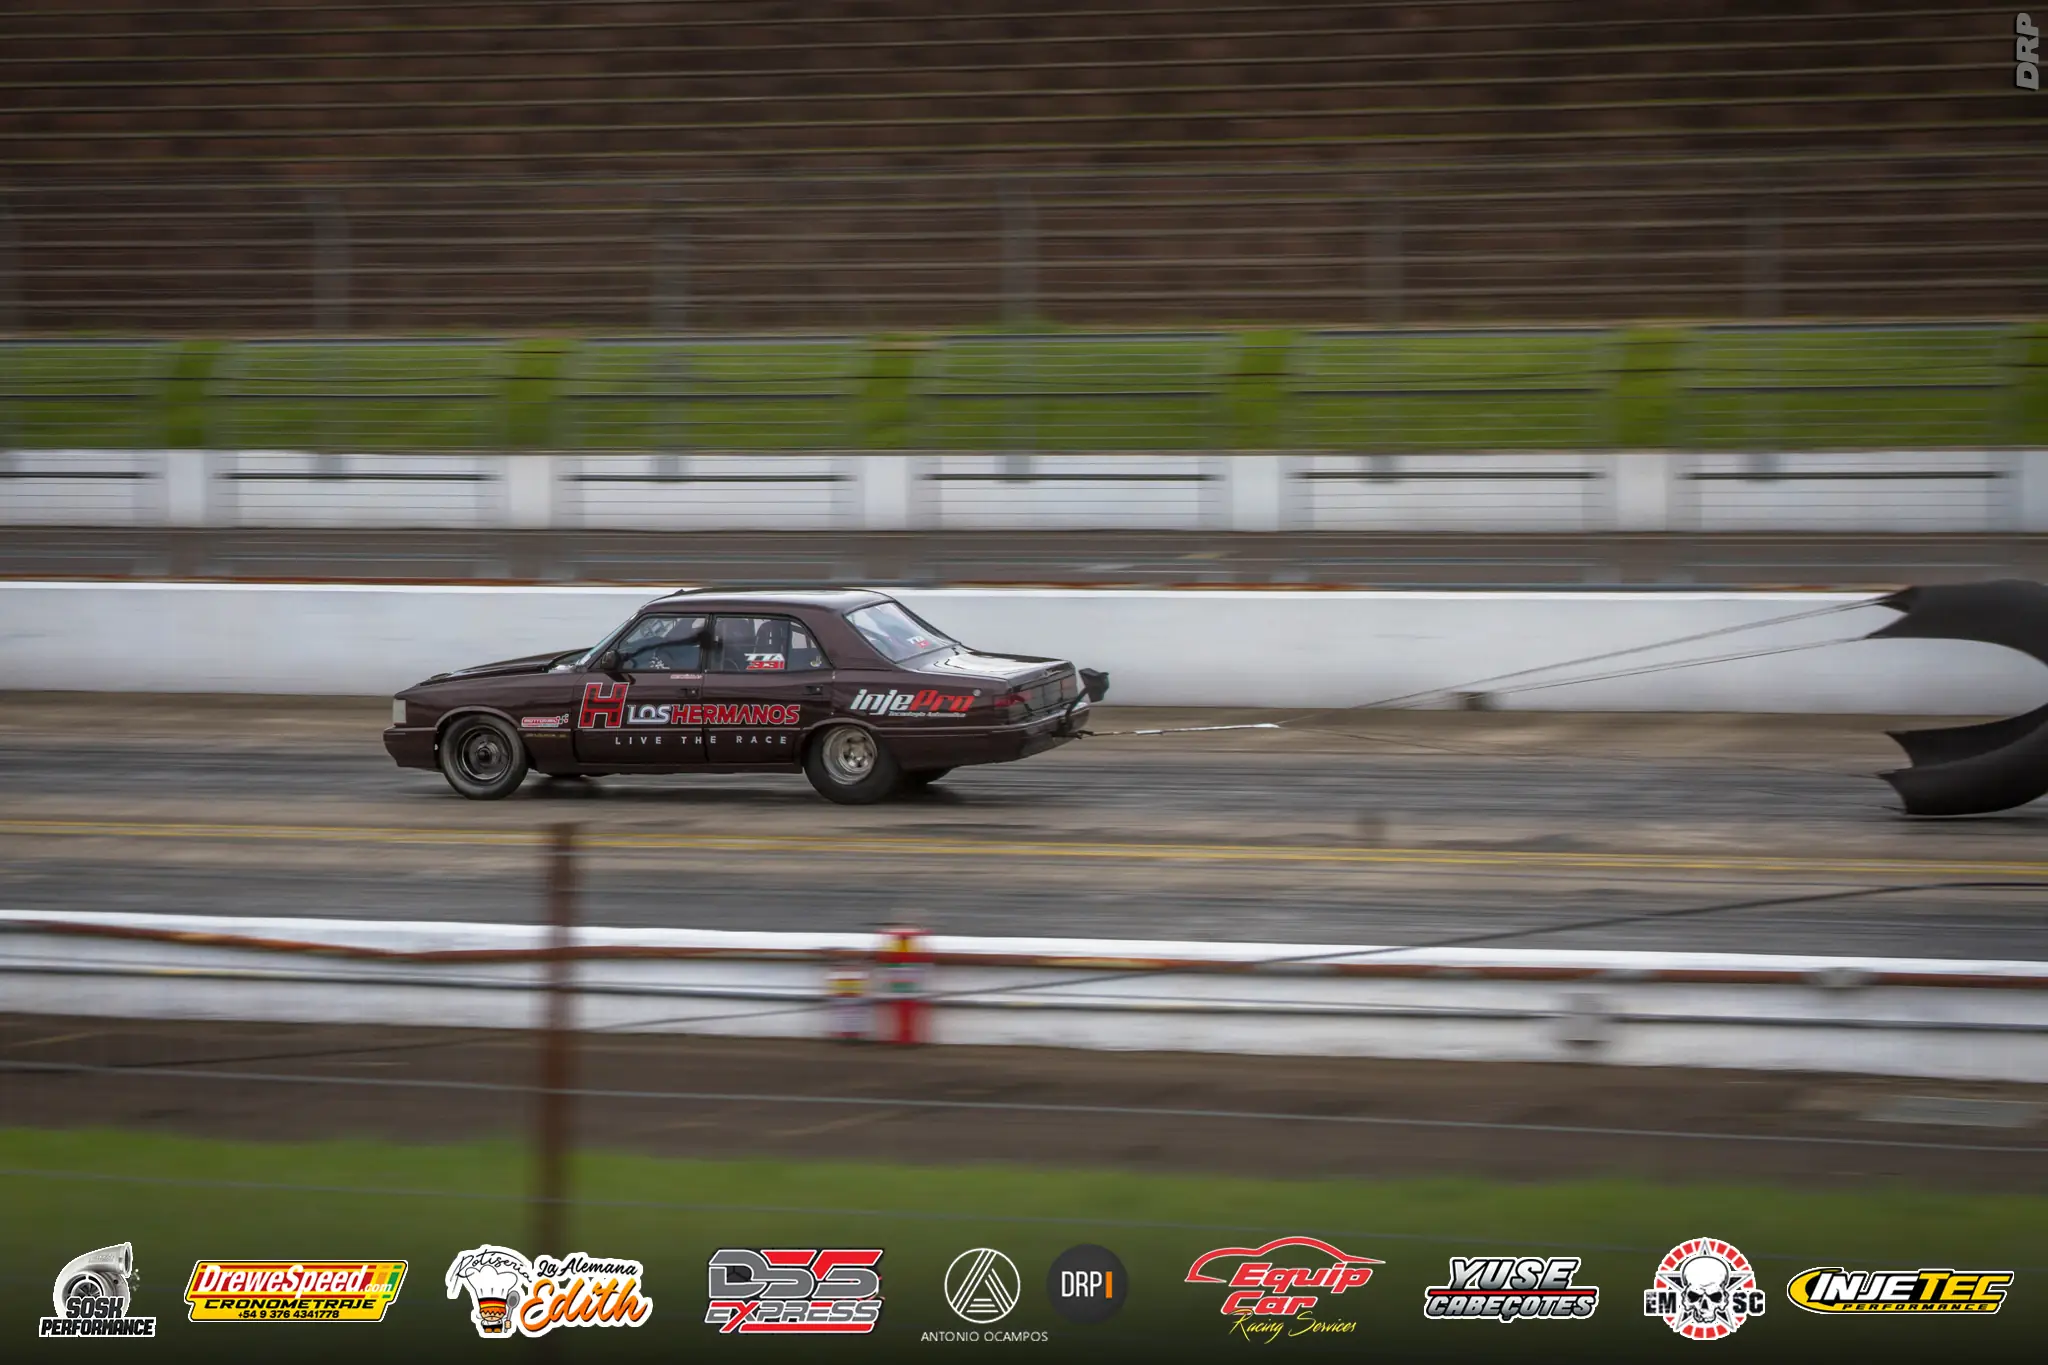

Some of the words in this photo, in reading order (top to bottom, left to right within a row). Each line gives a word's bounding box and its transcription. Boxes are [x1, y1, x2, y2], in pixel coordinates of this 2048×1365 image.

[744, 653, 785, 661] TTA
[615, 736, 662, 745] LIVE
[681, 736, 716, 745] THE
[736, 735, 787, 744] RACE
